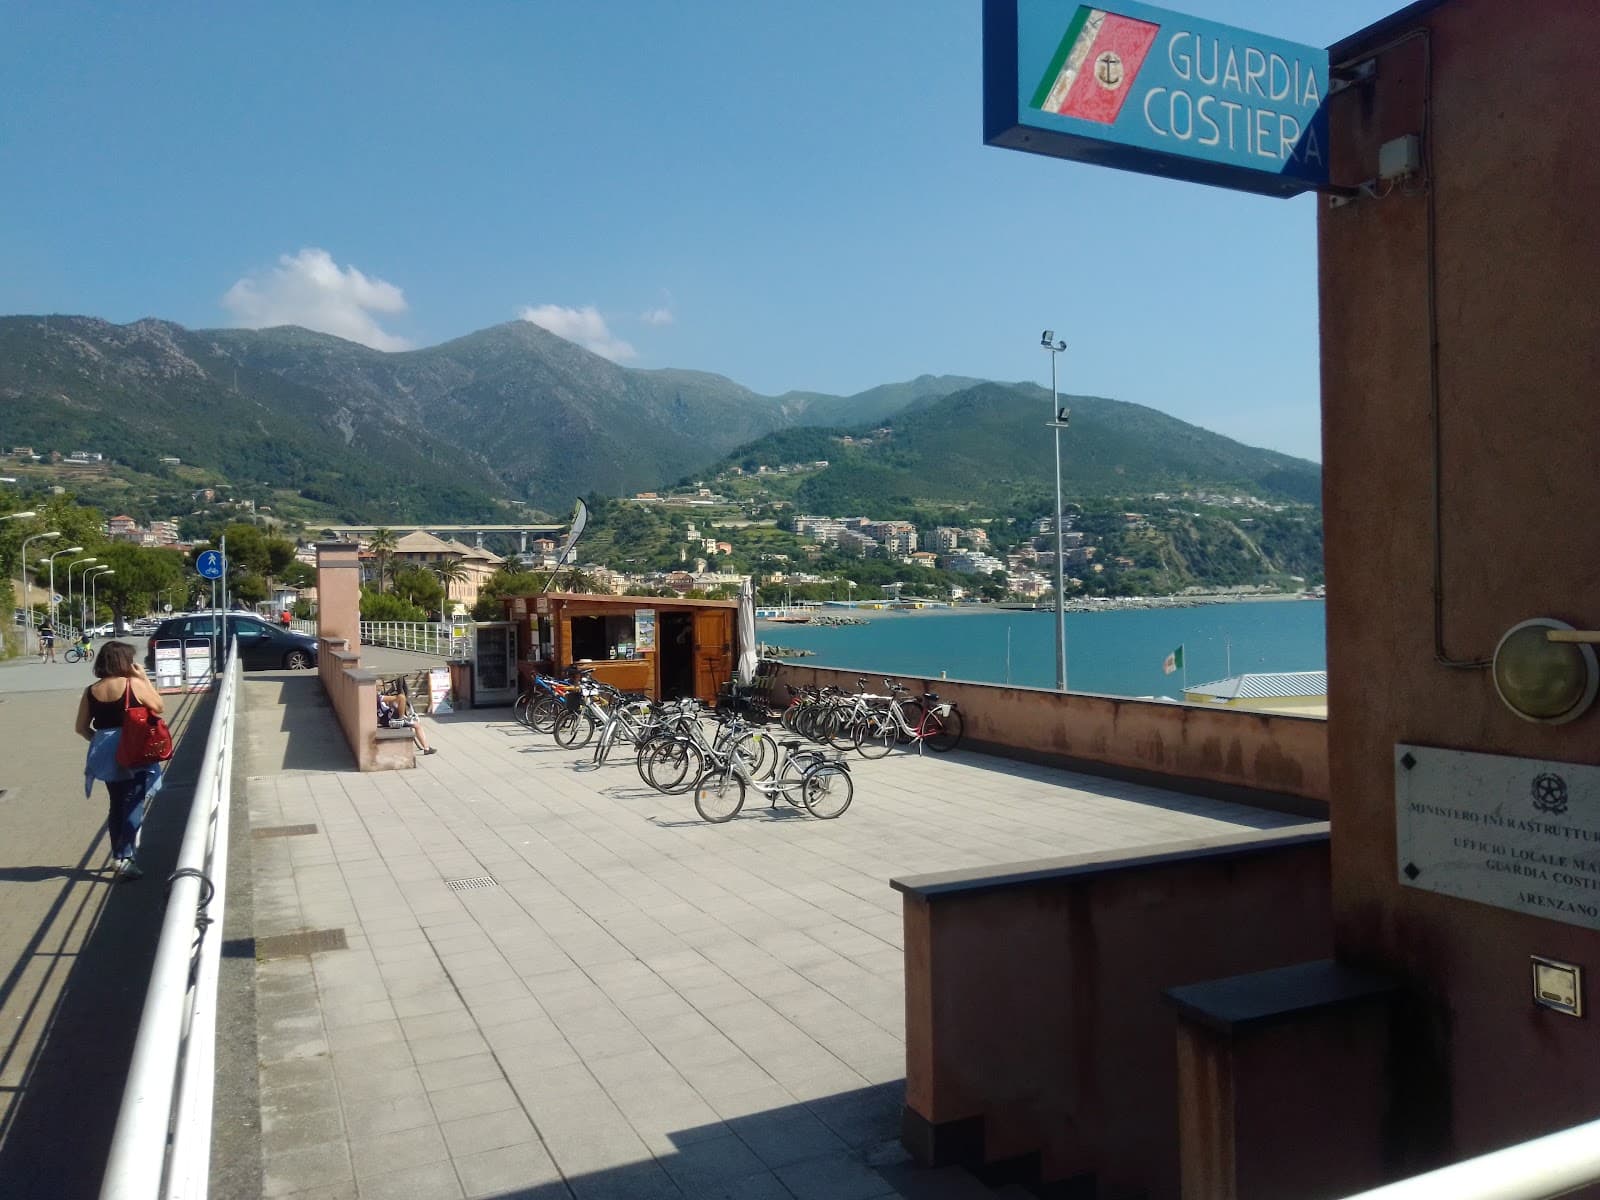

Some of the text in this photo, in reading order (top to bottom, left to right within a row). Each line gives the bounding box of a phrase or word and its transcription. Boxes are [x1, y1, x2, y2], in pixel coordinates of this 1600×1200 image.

[1168, 31, 1321, 107] GUARDIA
[1143, 87, 1322, 166] COSTIERA
[1409, 802, 1480, 822] MINISTERO
[1453, 837, 1600, 874] UFFICIO LOCALE MA
[1485, 859, 1600, 891] GUARDIA COSTI
[1517, 891, 1599, 918] ARENZANO
